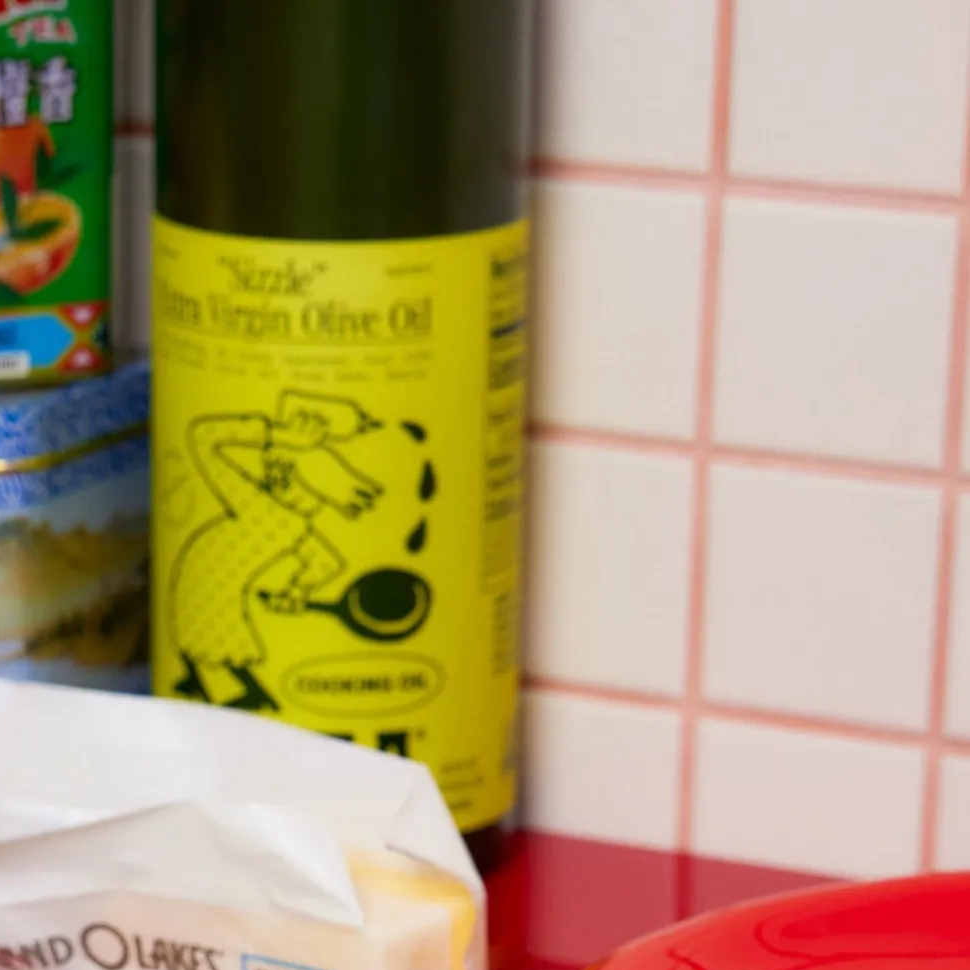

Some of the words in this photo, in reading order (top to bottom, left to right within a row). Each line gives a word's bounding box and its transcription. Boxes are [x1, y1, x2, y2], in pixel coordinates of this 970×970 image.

[205, 294, 292, 342] Virgin
[299, 297, 380, 337] Olive
[387, 296, 433, 338] Oil
